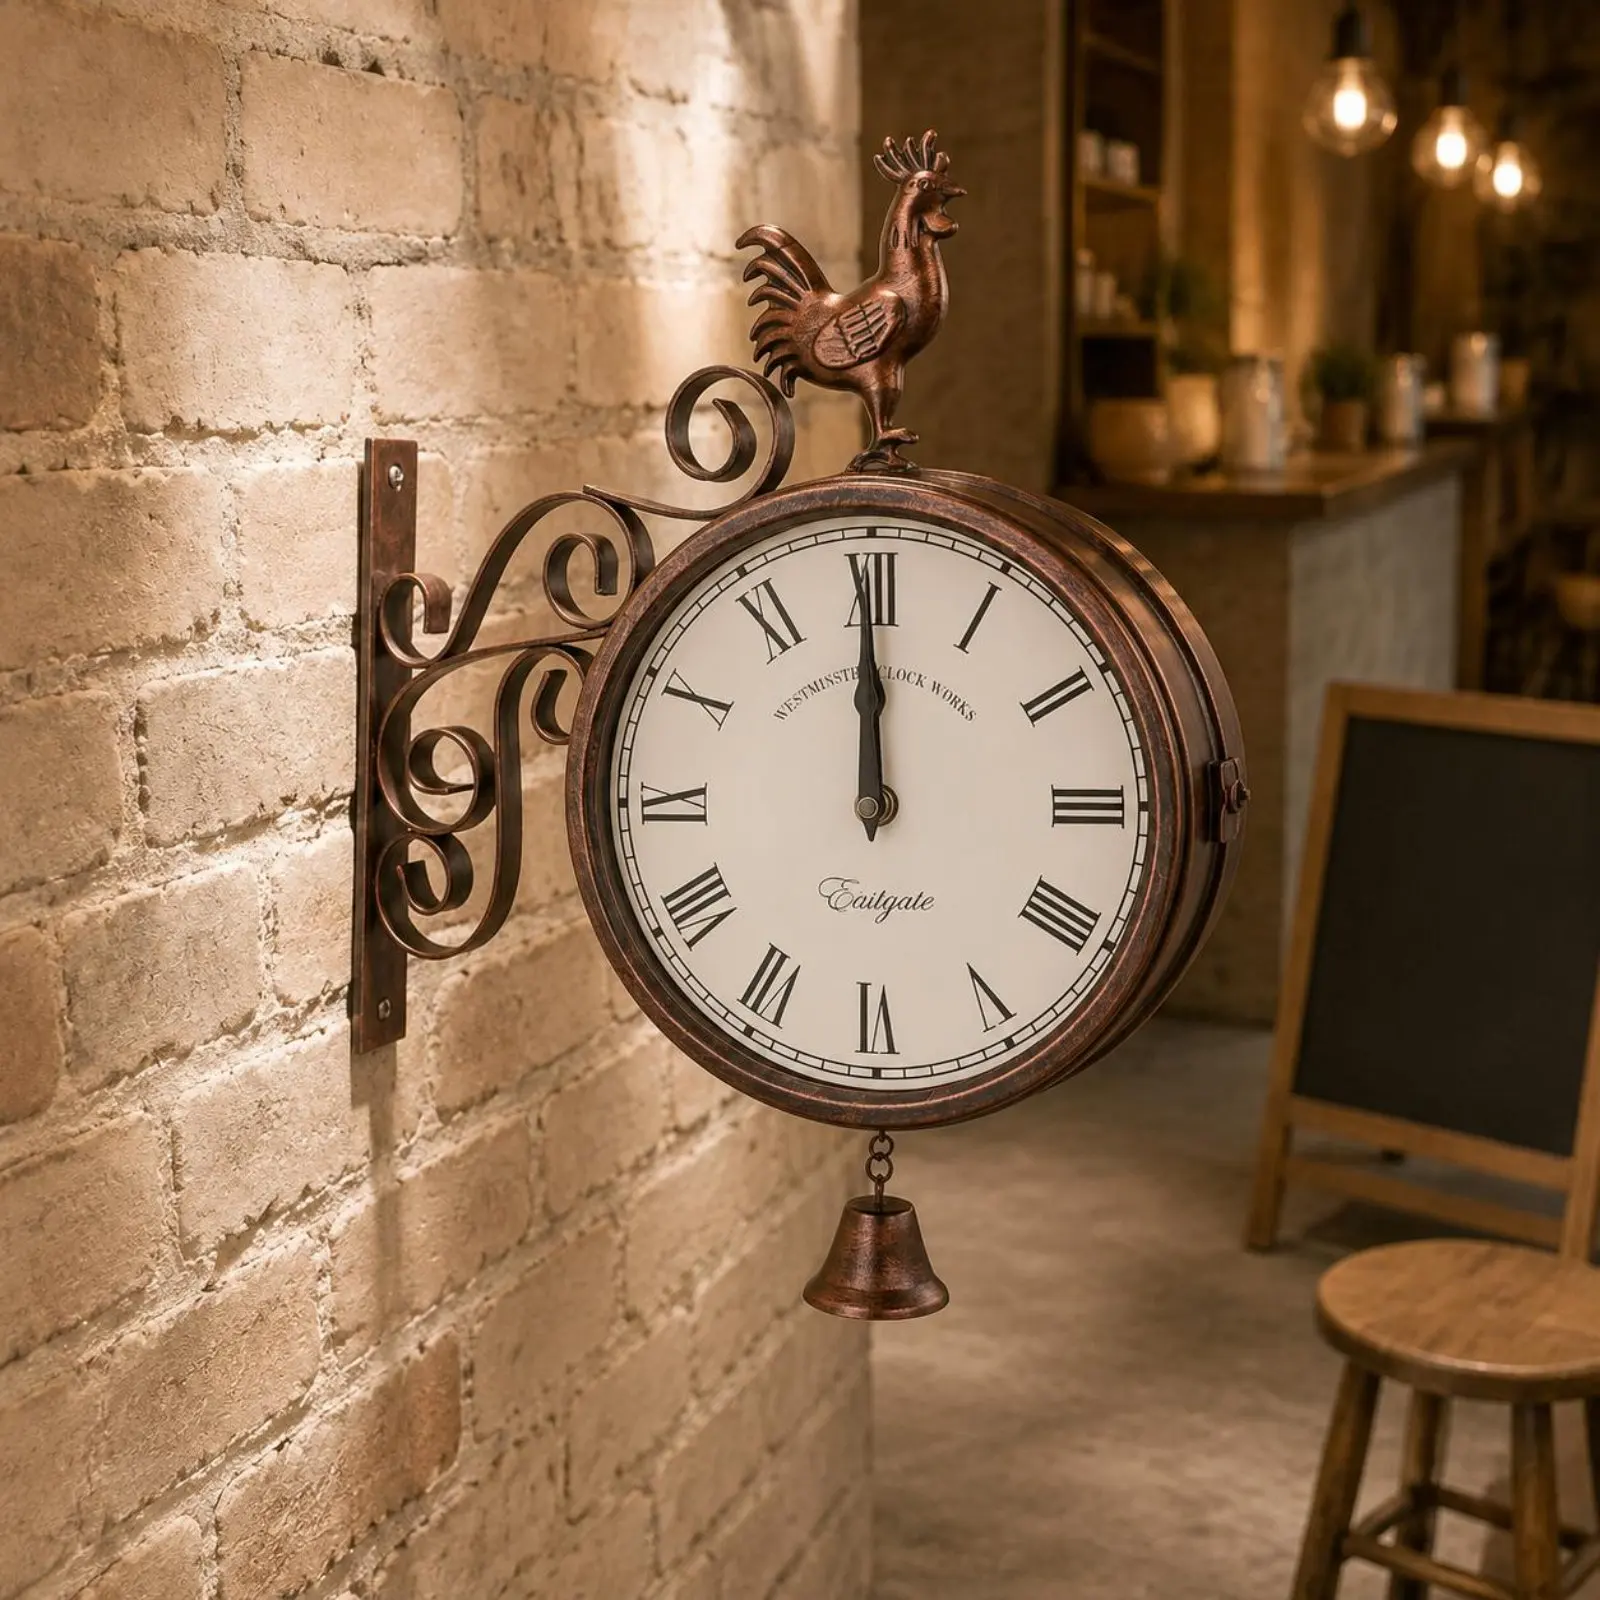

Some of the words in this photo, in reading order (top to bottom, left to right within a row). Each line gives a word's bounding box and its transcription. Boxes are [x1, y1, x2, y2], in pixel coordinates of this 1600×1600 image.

[735, 577, 807, 664] XI
[844, 551, 899, 628] XII
[954, 580, 1002, 655] I
[661, 668, 734, 731] X
[773, 664, 862, 720] WESTMINSTE
[877, 664, 925, 689] CLOCK
[931, 680, 977, 722] WORKS
[1019, 666, 1094, 727] II
[640, 781, 708, 827] IX
[1051, 783, 1126, 830] III
[660, 862, 737, 951] VIII
[1018, 875, 1101, 956] IIII
[737, 942, 801, 1029] VII
[854, 981, 901, 1056] VI
[966, 962, 1016, 1033] V
